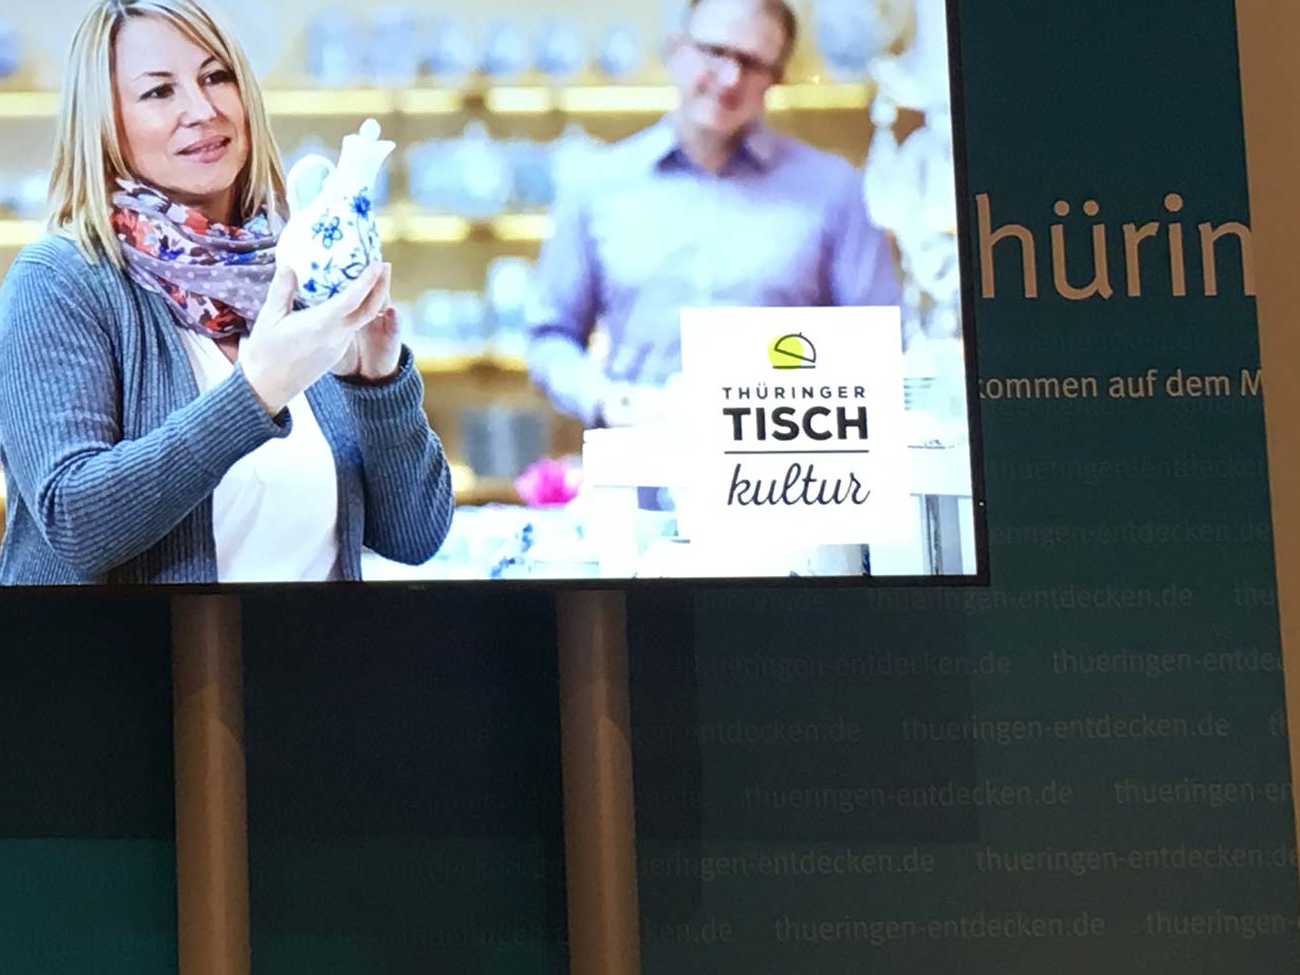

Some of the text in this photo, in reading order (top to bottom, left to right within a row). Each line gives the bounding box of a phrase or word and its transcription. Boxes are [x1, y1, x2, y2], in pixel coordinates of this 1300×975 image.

[975, 192, 1257, 301] hürin
[722, 382, 866, 400] THÜRINGER
[1108, 368, 1158, 398] auf
[1165, 368, 1231, 398] dem
[722, 406, 868, 441] TISCH
[727, 462, 871, 506] kultur
[901, 710, 1229, 748] thueringen-entdecken.de
[743, 779, 1073, 815] thueringen-entdecken.de
[975, 842, 1298, 876] thueringen-entdecken.de
[773, 911, 1106, 947] thueringen-entdecken.de
